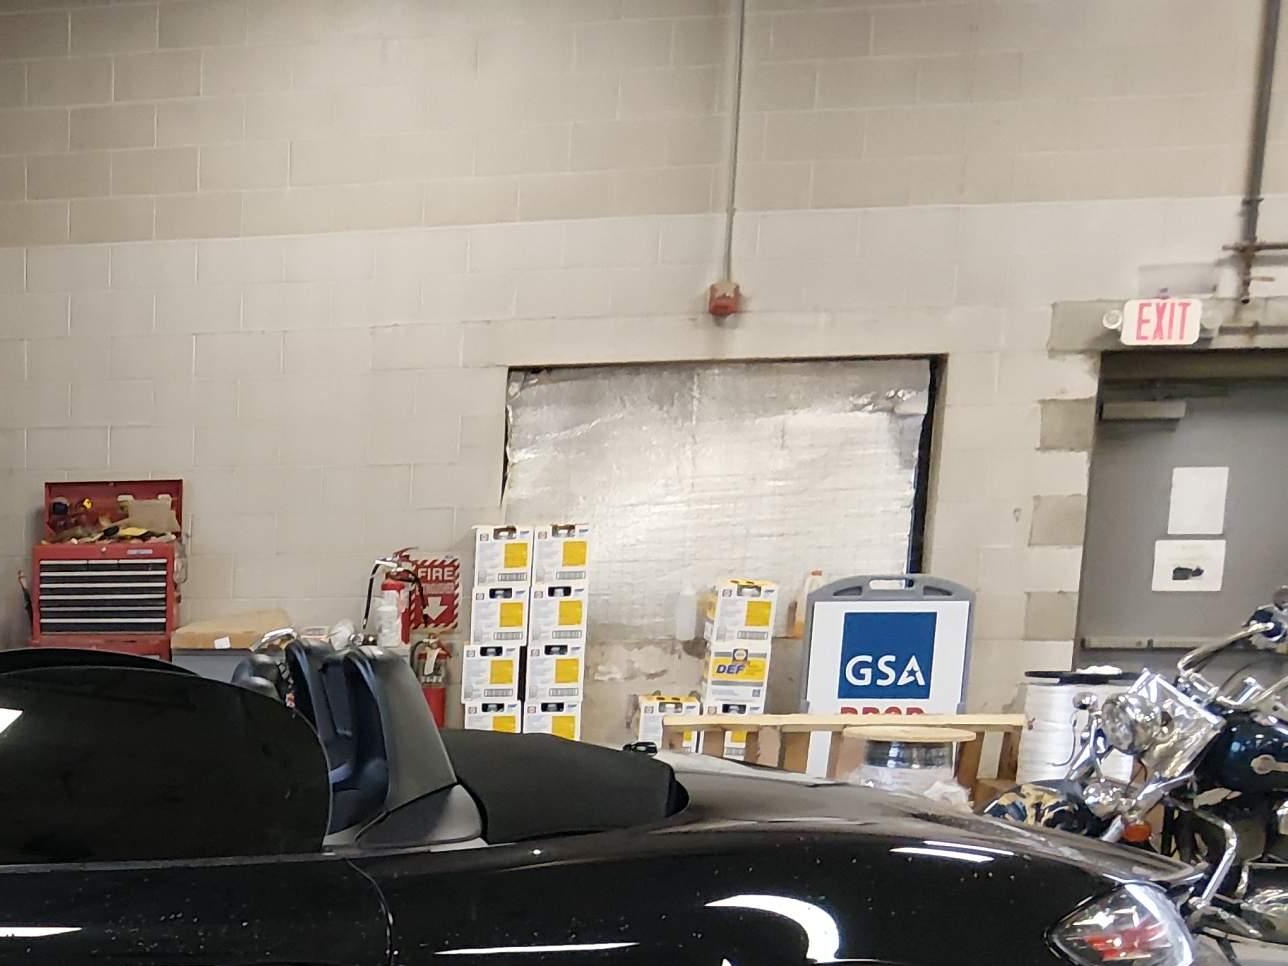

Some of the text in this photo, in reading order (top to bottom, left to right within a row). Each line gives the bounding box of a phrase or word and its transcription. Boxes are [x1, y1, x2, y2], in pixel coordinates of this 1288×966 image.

[1136, 303, 1191, 340] EXIT
[417, 567, 455, 581] FIRE
[716, 664, 745, 675] DEF
[845, 655, 926, 686] GSA
